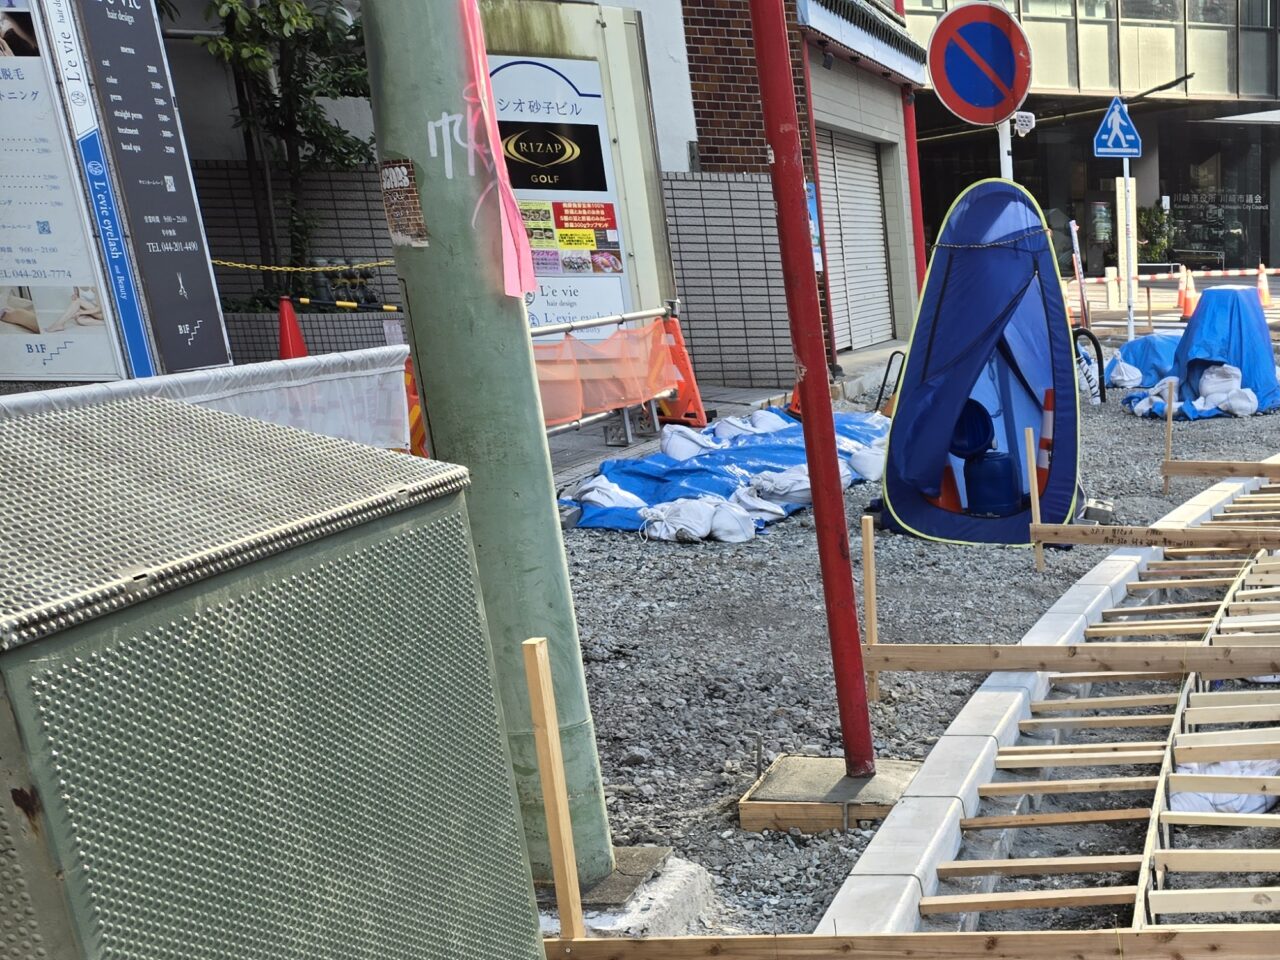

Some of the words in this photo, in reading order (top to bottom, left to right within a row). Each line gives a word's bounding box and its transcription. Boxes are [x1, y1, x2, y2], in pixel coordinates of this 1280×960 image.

[58, 32, 75, 54] vie
[0, 68, 24, 80] 脱毛
[497, 98, 582, 116] シオ砂子ビル
[519, 142, 562, 153] RIZAP
[530, 174, 560, 184] GOLF
[104, 217, 121, 260] eyelash
[117, 276, 128, 300] Beauty
[561, 285, 580, 297] vie
[559, 300, 577, 308] design
[178, 324, 190, 334] B1F
[25, 343, 47, 354] B1F
